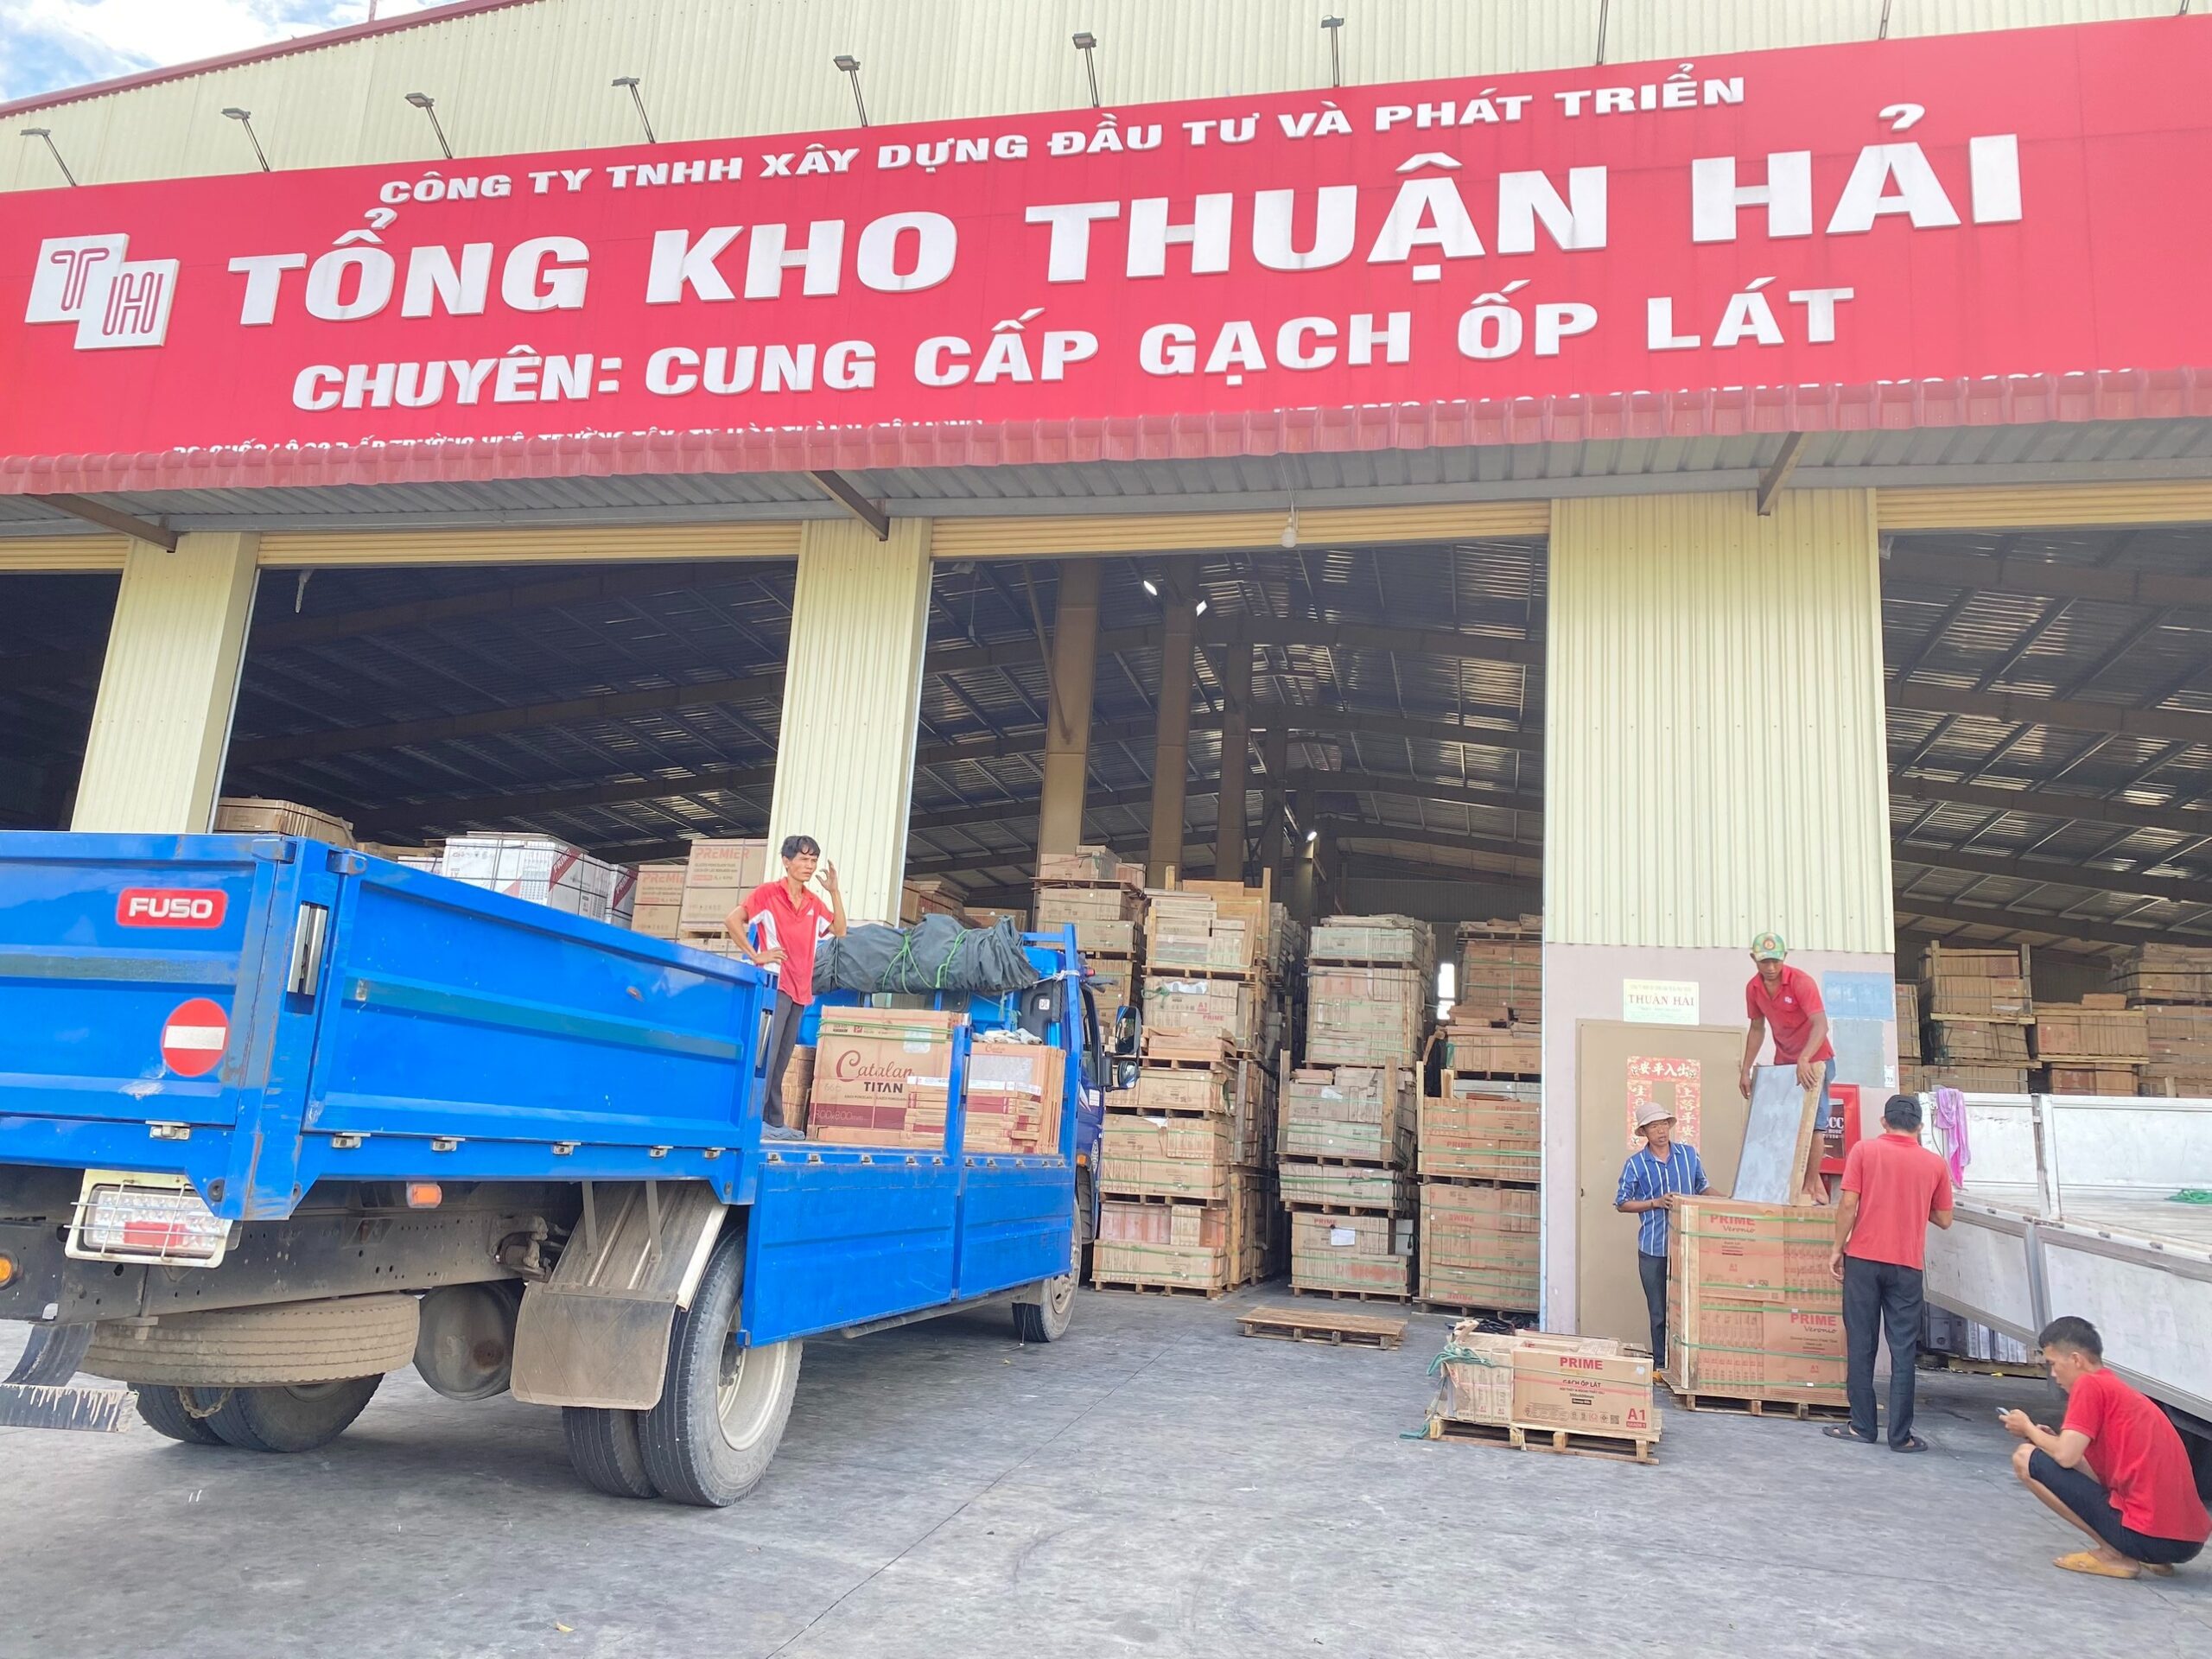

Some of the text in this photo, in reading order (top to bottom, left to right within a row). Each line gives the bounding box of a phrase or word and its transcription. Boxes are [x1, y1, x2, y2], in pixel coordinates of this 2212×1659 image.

[378, 61, 1747, 205] CÔNG TY TNHH XÂY DỰNG ĐẦU TƯ VÀ PHÁT TRIỂN
[226, 100, 2024, 328] TỔNG KHO THUẬN HẢI
[292, 275, 1857, 413] CHUYÊN: CUNG CẤP GẠCH ỐP LÁT
[128, 897, 213, 919] FUSO
[864, 1081, 903, 1093] TITAN
[1710, 1214, 1755, 1225] PRIME
[1790, 1313, 1837, 1326] PRIME
[1560, 1357, 1603, 1370] PRIME
[1628, 1408, 1645, 1421] A1
